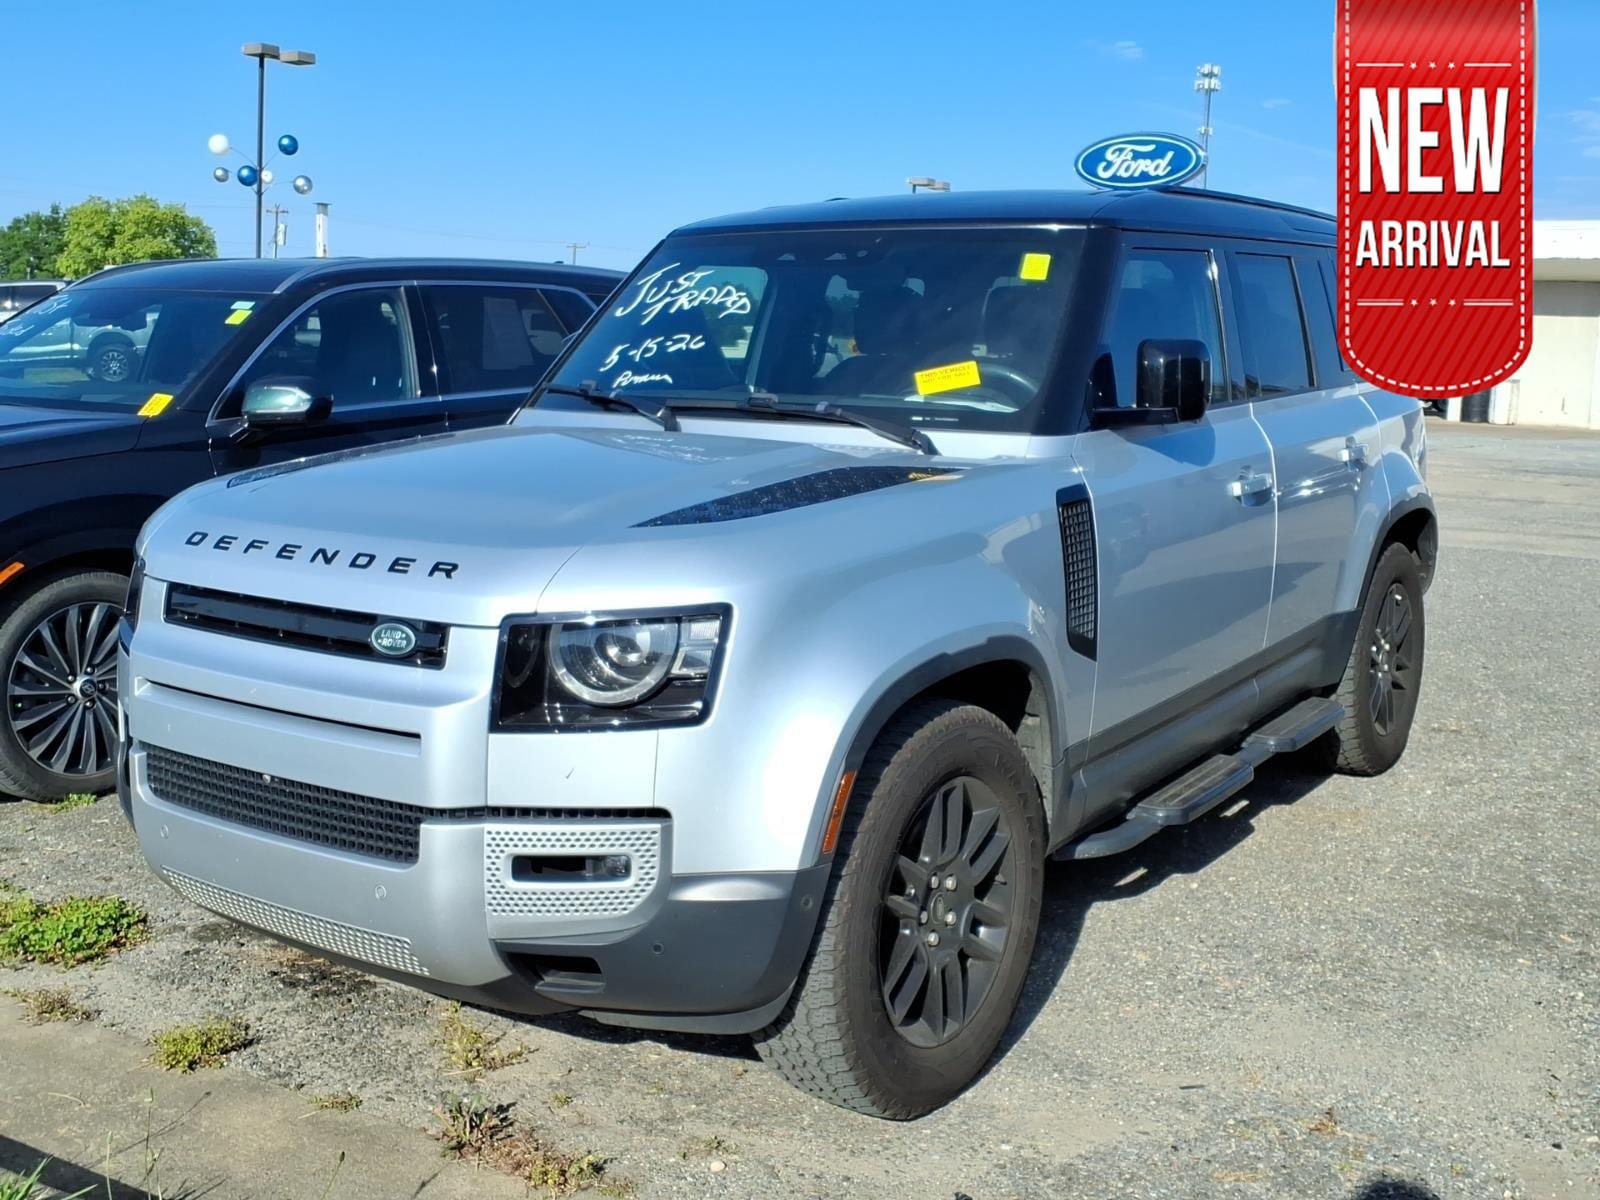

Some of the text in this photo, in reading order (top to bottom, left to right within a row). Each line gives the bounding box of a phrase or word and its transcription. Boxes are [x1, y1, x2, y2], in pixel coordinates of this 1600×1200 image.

[1097, 143, 1175, 179] Ford
[614, 262, 714, 317] JUST
[640, 285, 751, 326] TRADED
[184, 530, 459, 580] DEFENDER
[381, 629, 402, 639] LAND
[381, 638, 407, 649] ROVER
